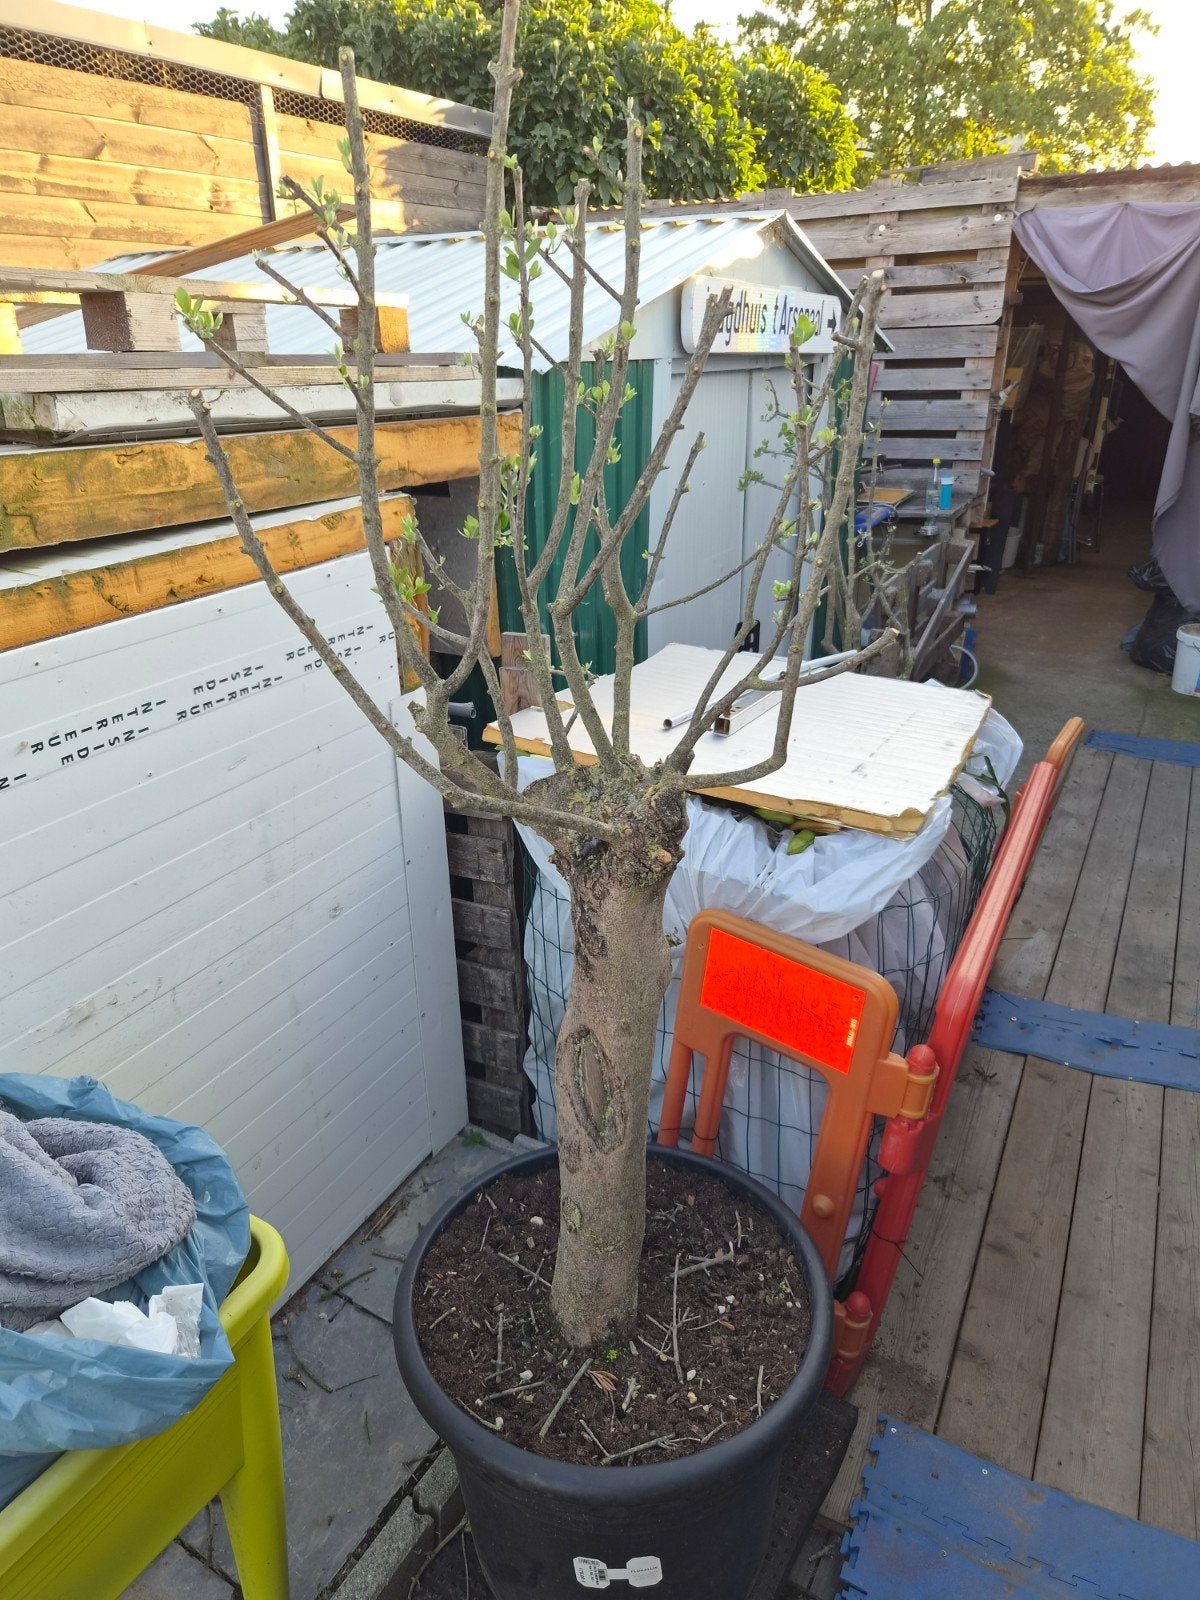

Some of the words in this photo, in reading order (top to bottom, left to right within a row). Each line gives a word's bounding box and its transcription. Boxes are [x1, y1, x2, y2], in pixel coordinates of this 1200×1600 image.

[285, 624, 373, 662] INTEREUR
[176, 675, 283, 722] INTERIEUR
[193, 664, 264, 695] INSIDE
[30, 699, 167, 754] INTERIEUR
[60, 726, 150, 766] INSIDE
